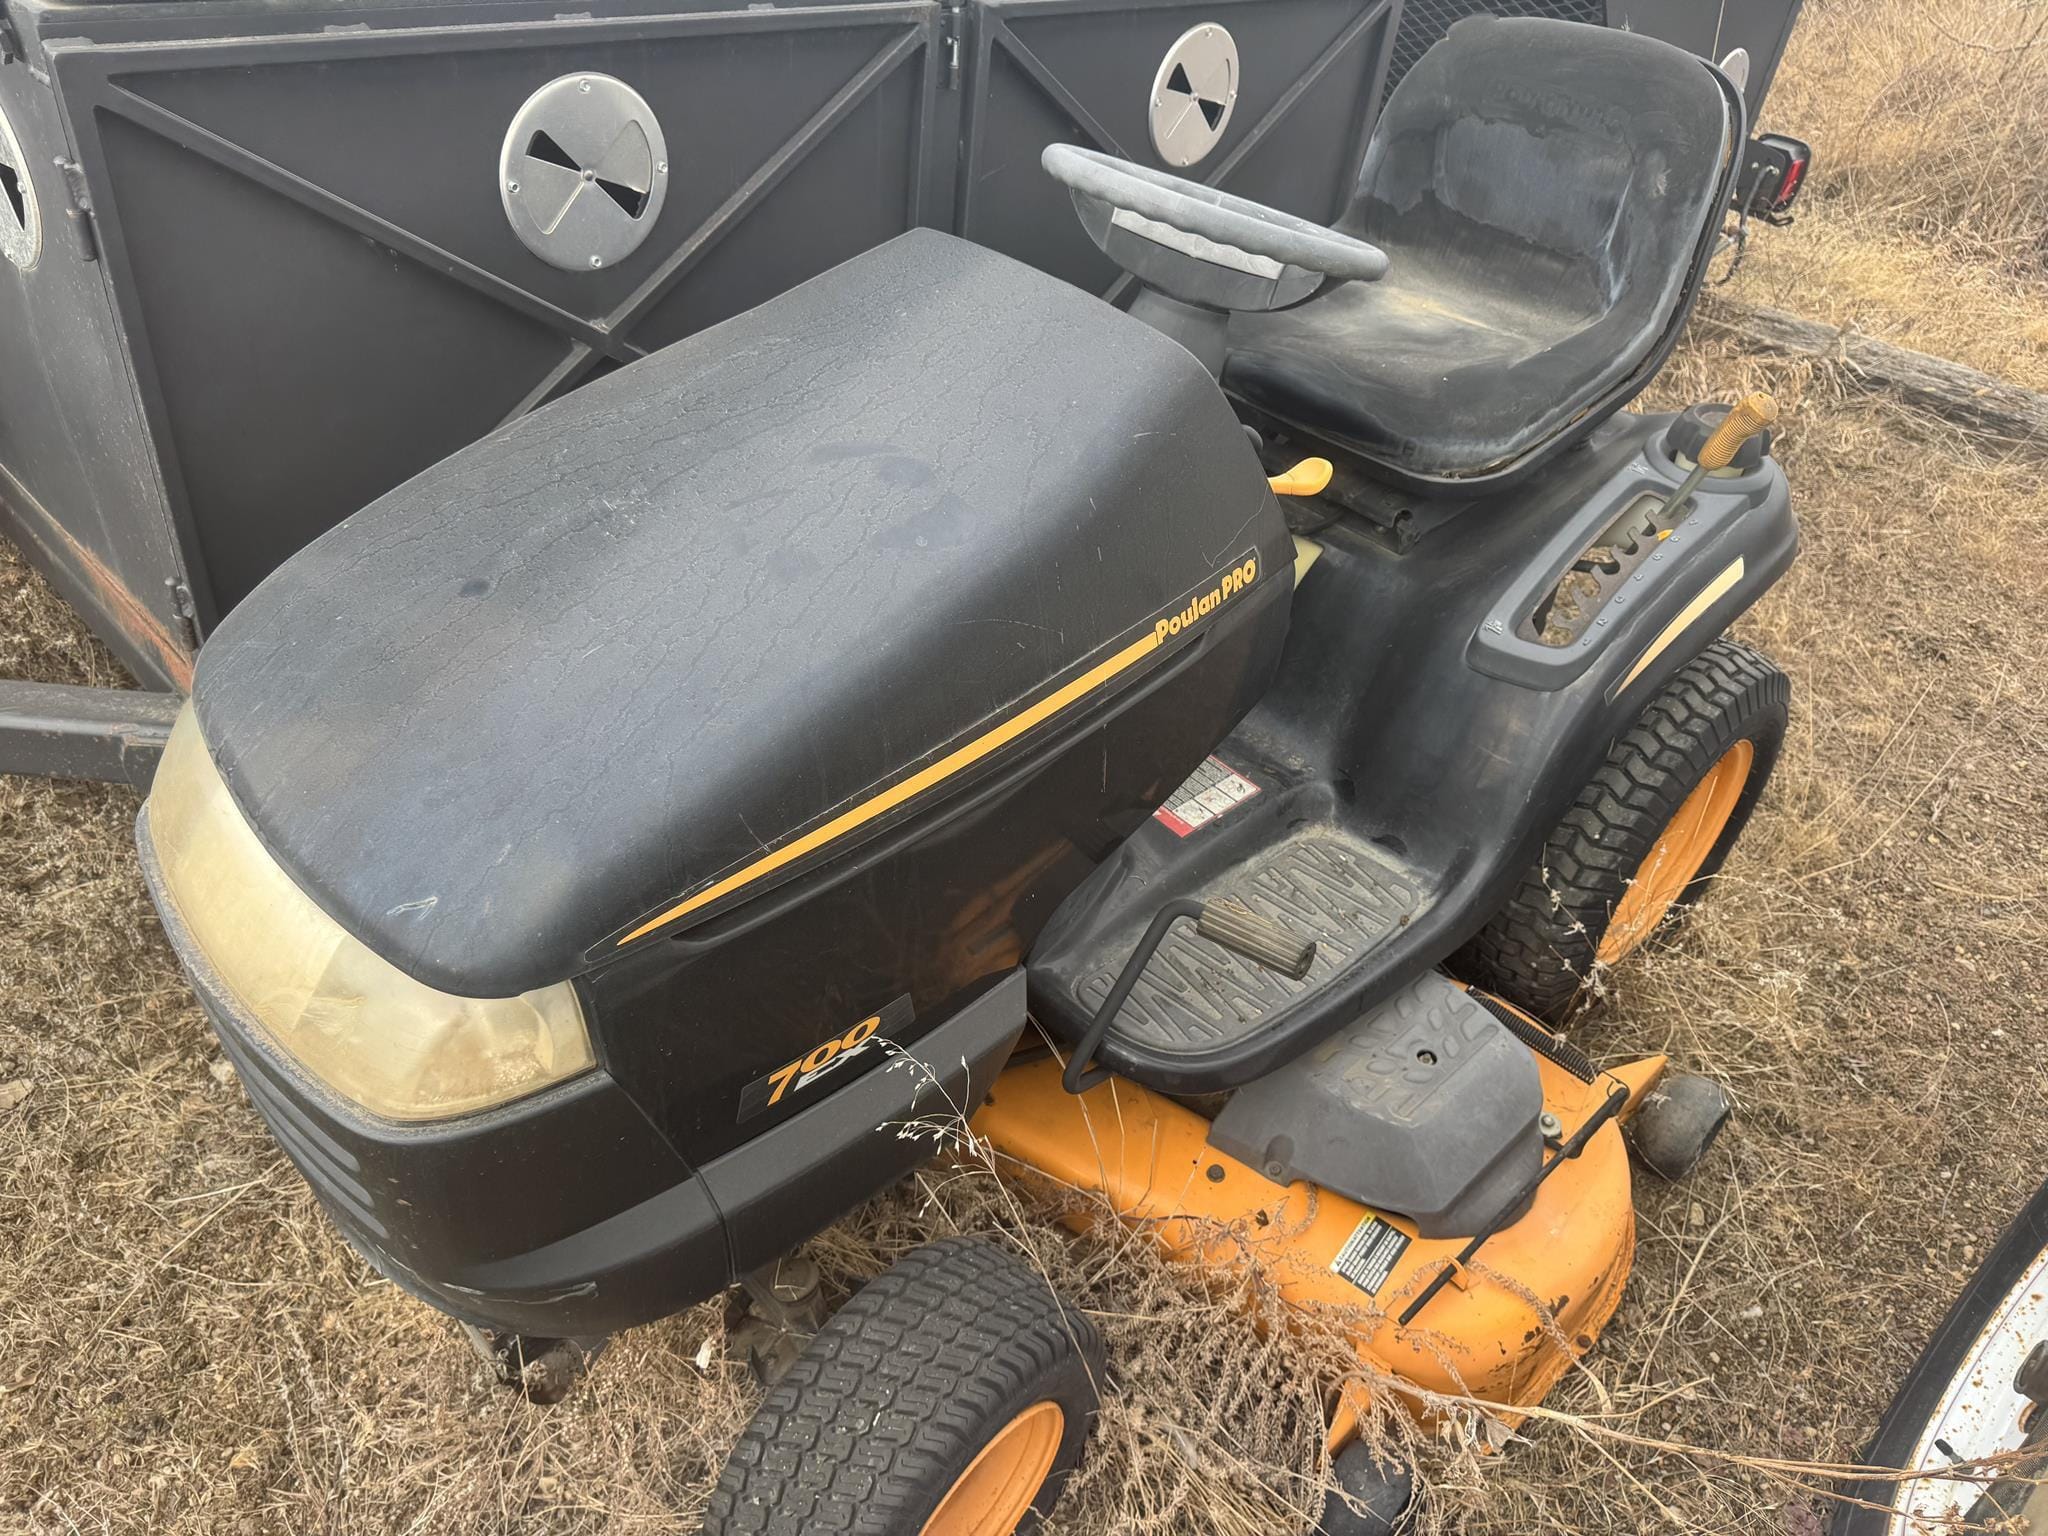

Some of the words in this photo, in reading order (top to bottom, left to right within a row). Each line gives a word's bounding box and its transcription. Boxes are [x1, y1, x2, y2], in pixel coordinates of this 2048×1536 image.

[1155, 588, 1222, 645] Poulan
[1221, 559, 1256, 601] PRO
[767, 1016, 881, 1107] 700
[793, 1035, 875, 1092] EX
